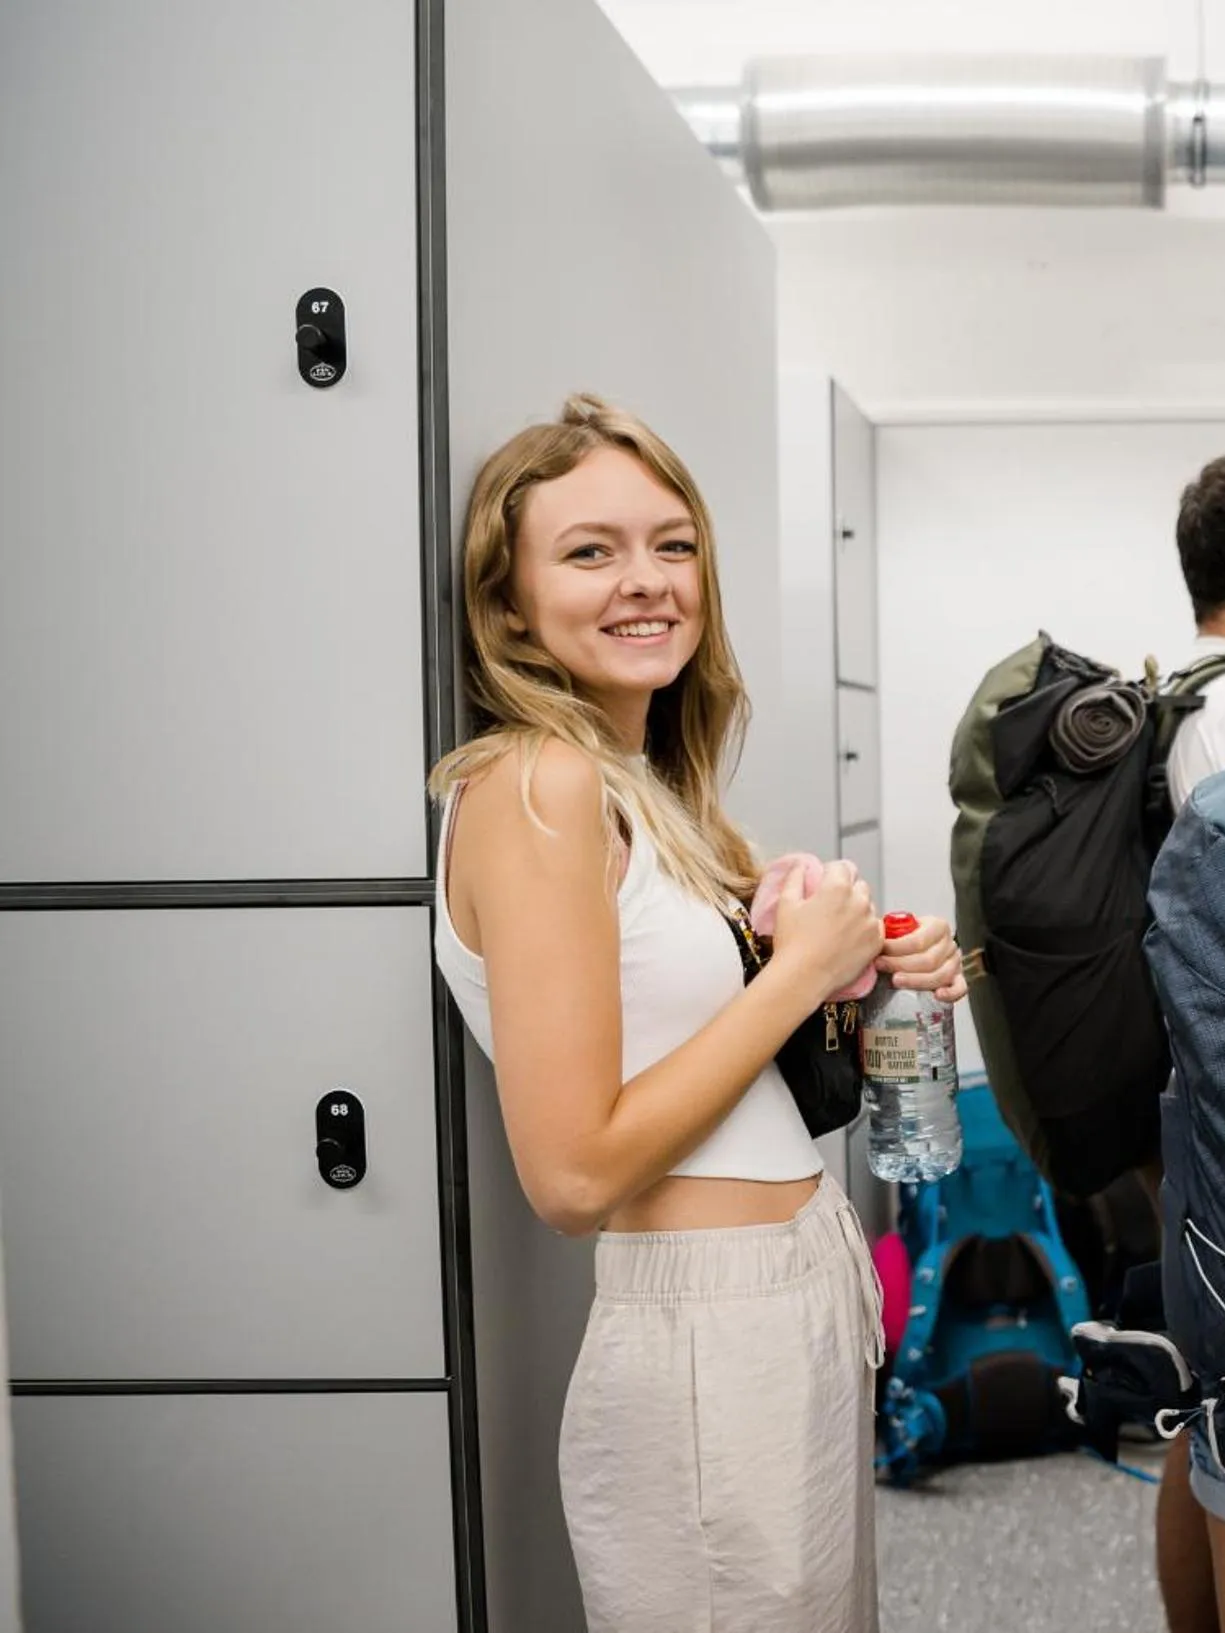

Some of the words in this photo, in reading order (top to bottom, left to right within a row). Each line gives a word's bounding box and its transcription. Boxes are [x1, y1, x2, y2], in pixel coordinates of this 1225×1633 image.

[311, 301, 329, 314] 67
[874, 1035, 899, 1047] BOTTLE
[330, 1103, 349, 1116] 68
